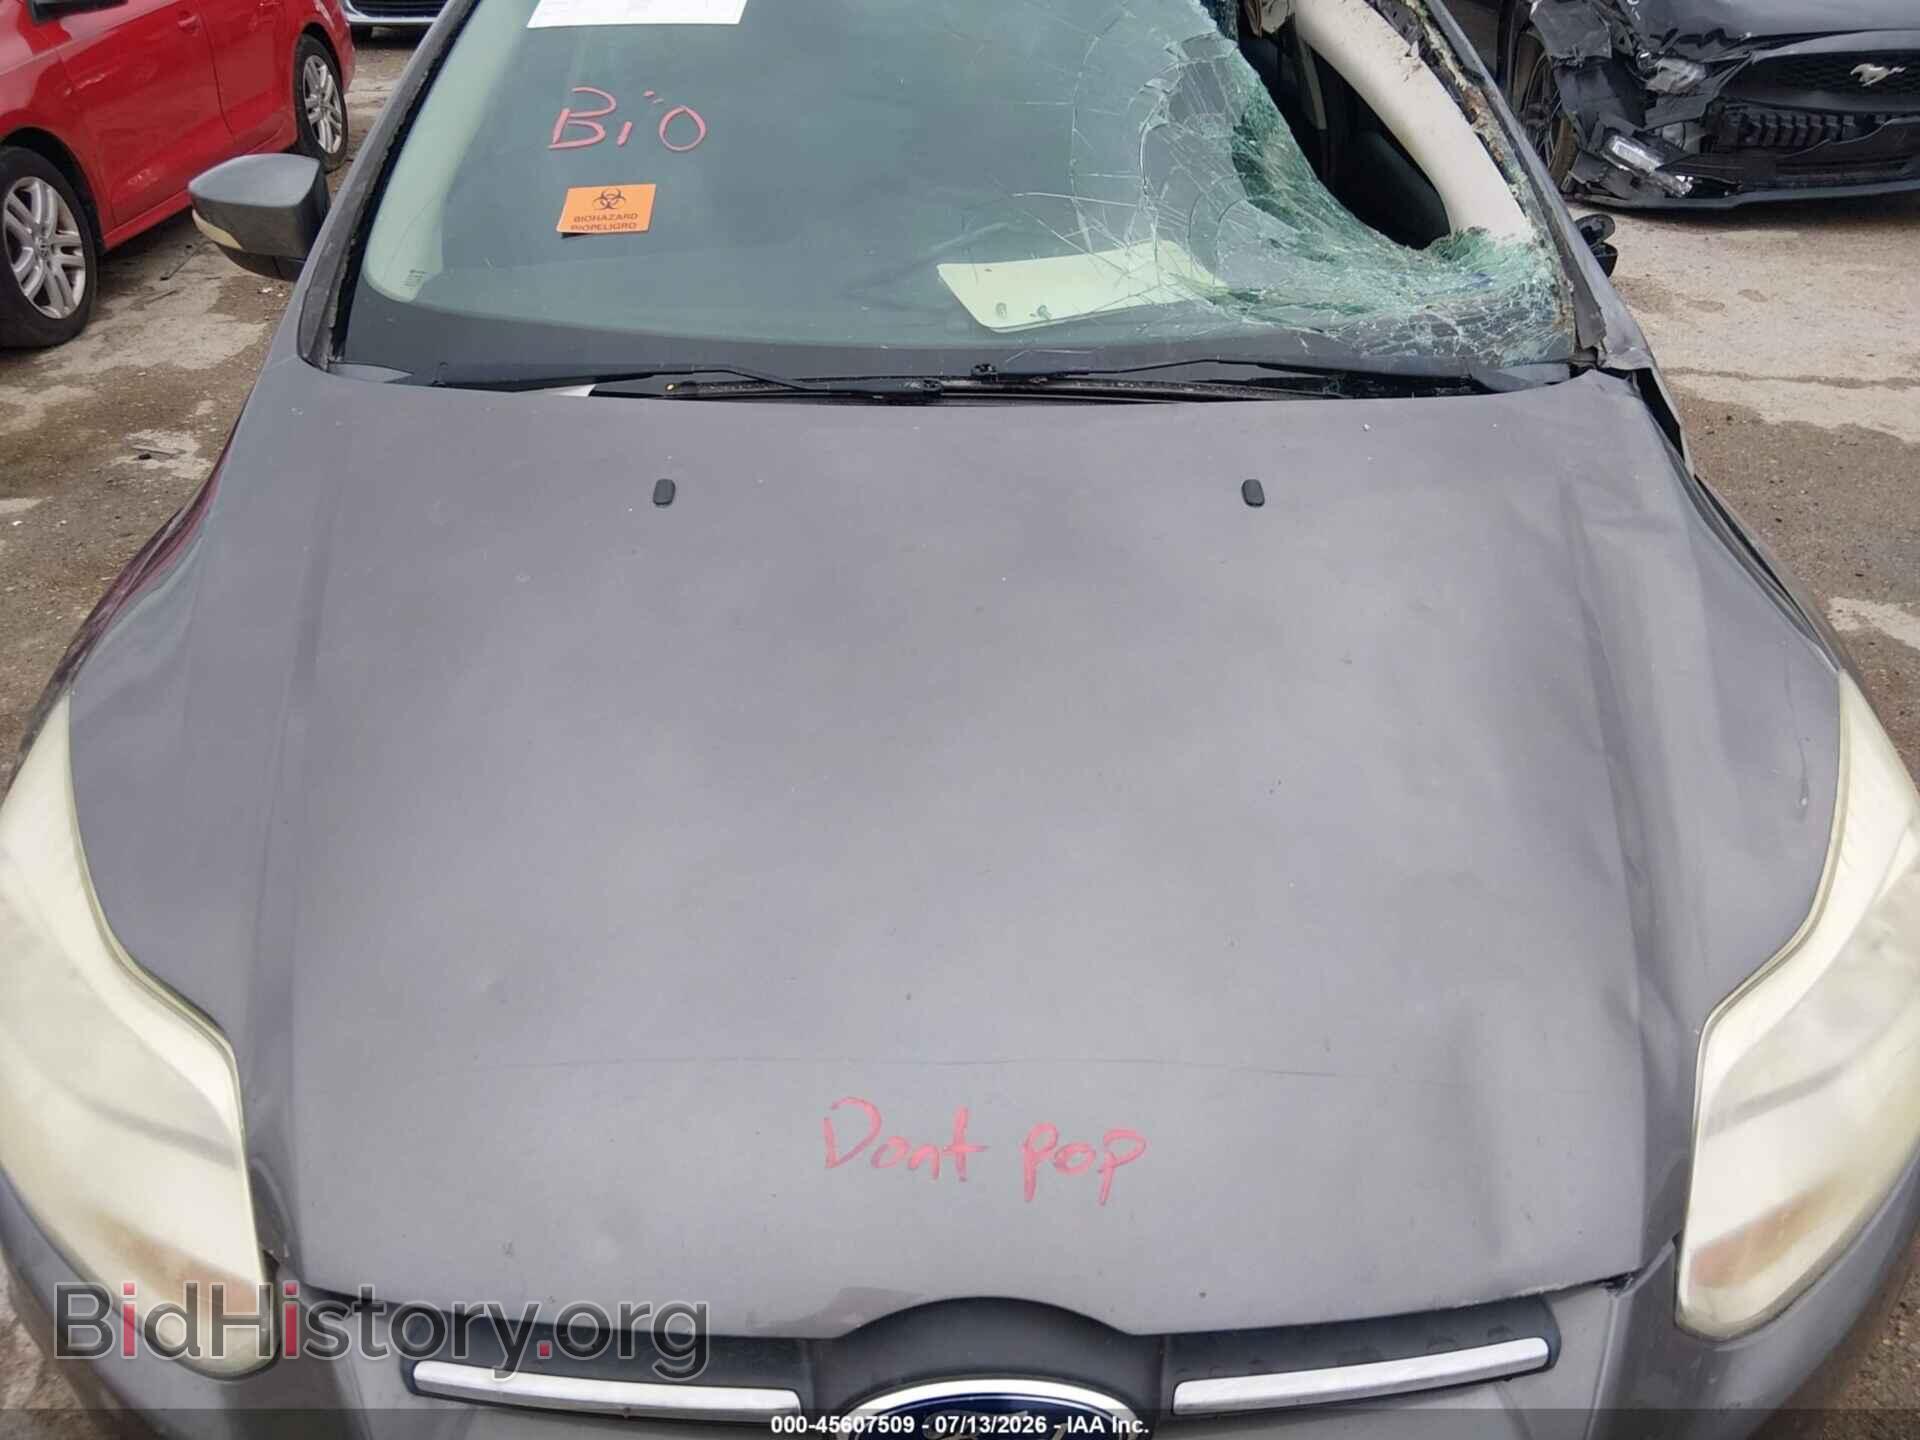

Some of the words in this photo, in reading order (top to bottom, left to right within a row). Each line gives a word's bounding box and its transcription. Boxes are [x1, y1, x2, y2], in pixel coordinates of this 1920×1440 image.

[573, 212, 639, 223] BIOHAZARD
[823, 1096, 989, 1182] Dont
[1022, 1122, 1146, 1206] pop
